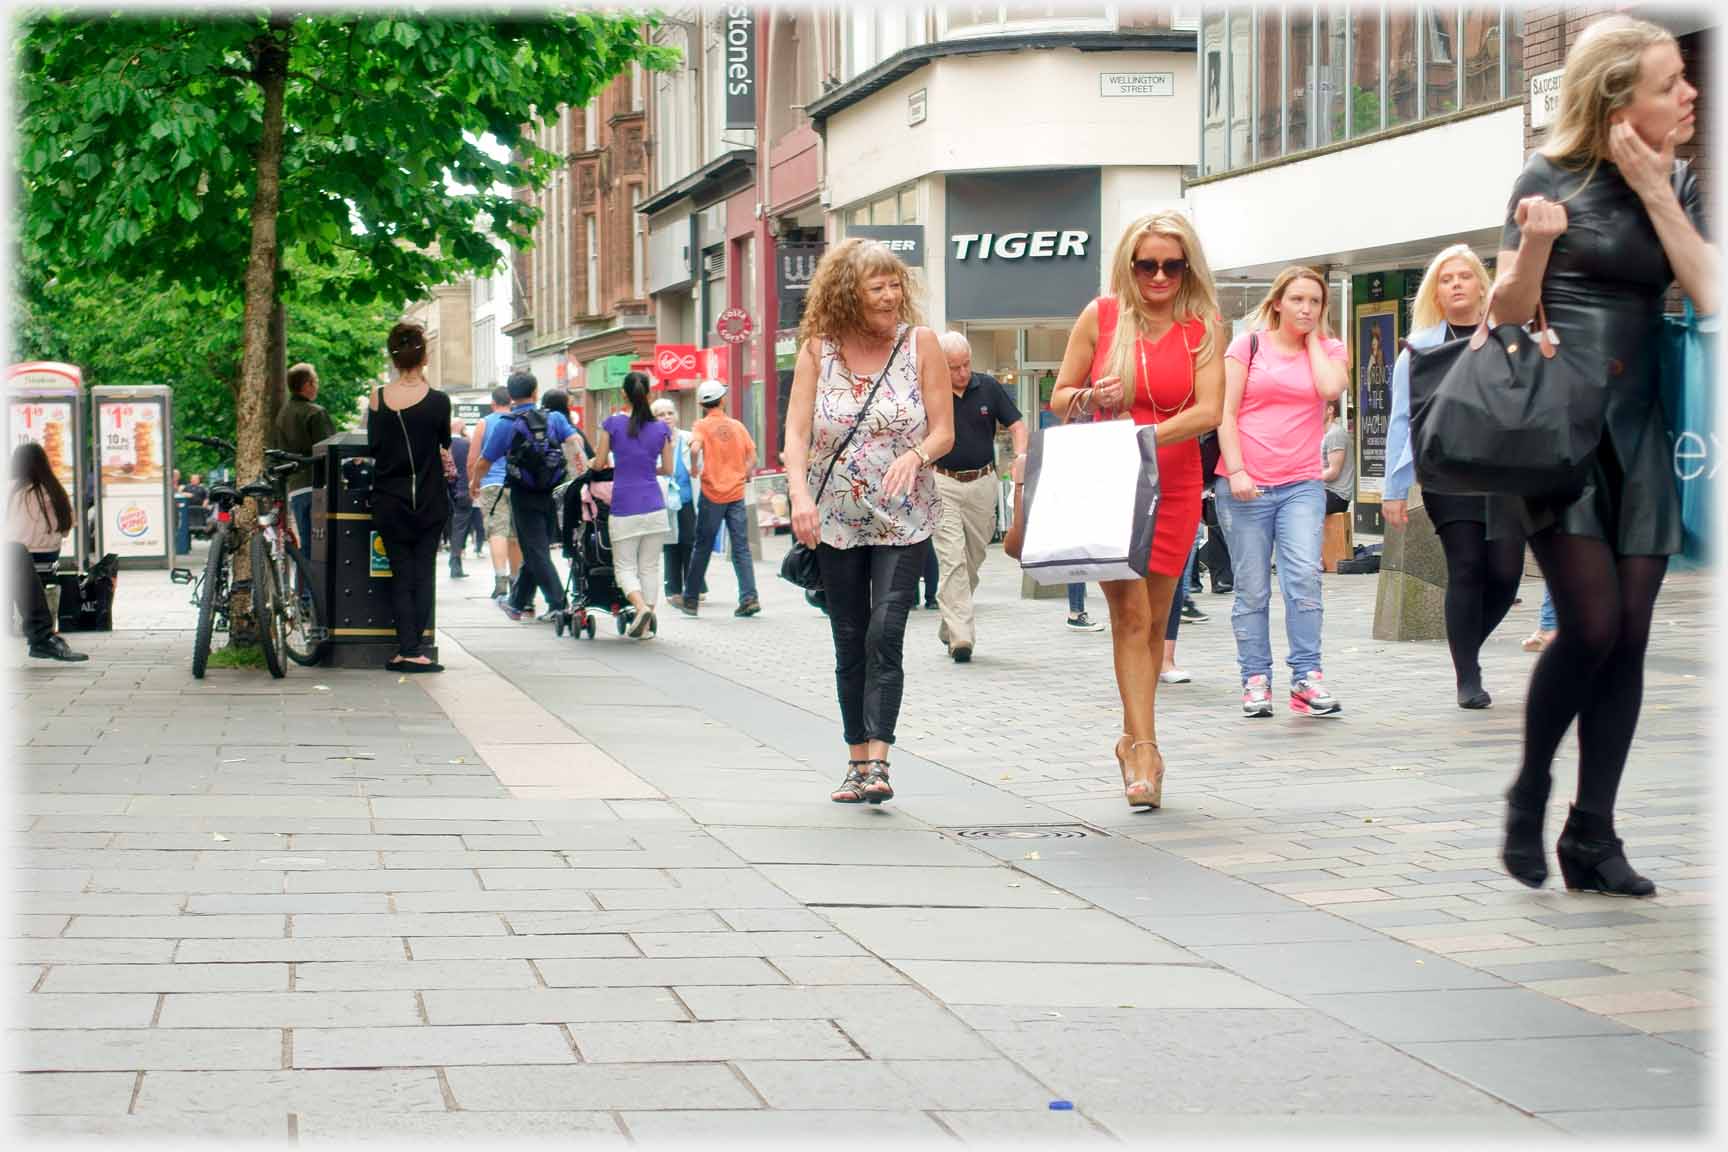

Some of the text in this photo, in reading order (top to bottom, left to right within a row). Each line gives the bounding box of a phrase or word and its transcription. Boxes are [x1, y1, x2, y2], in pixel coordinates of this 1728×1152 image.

[727, 5, 752, 96] stone's
[1109, 75, 1166, 85] WELLINGTON
[1120, 84, 1155, 93] STREET
[951, 229, 1090, 261] TIGER
